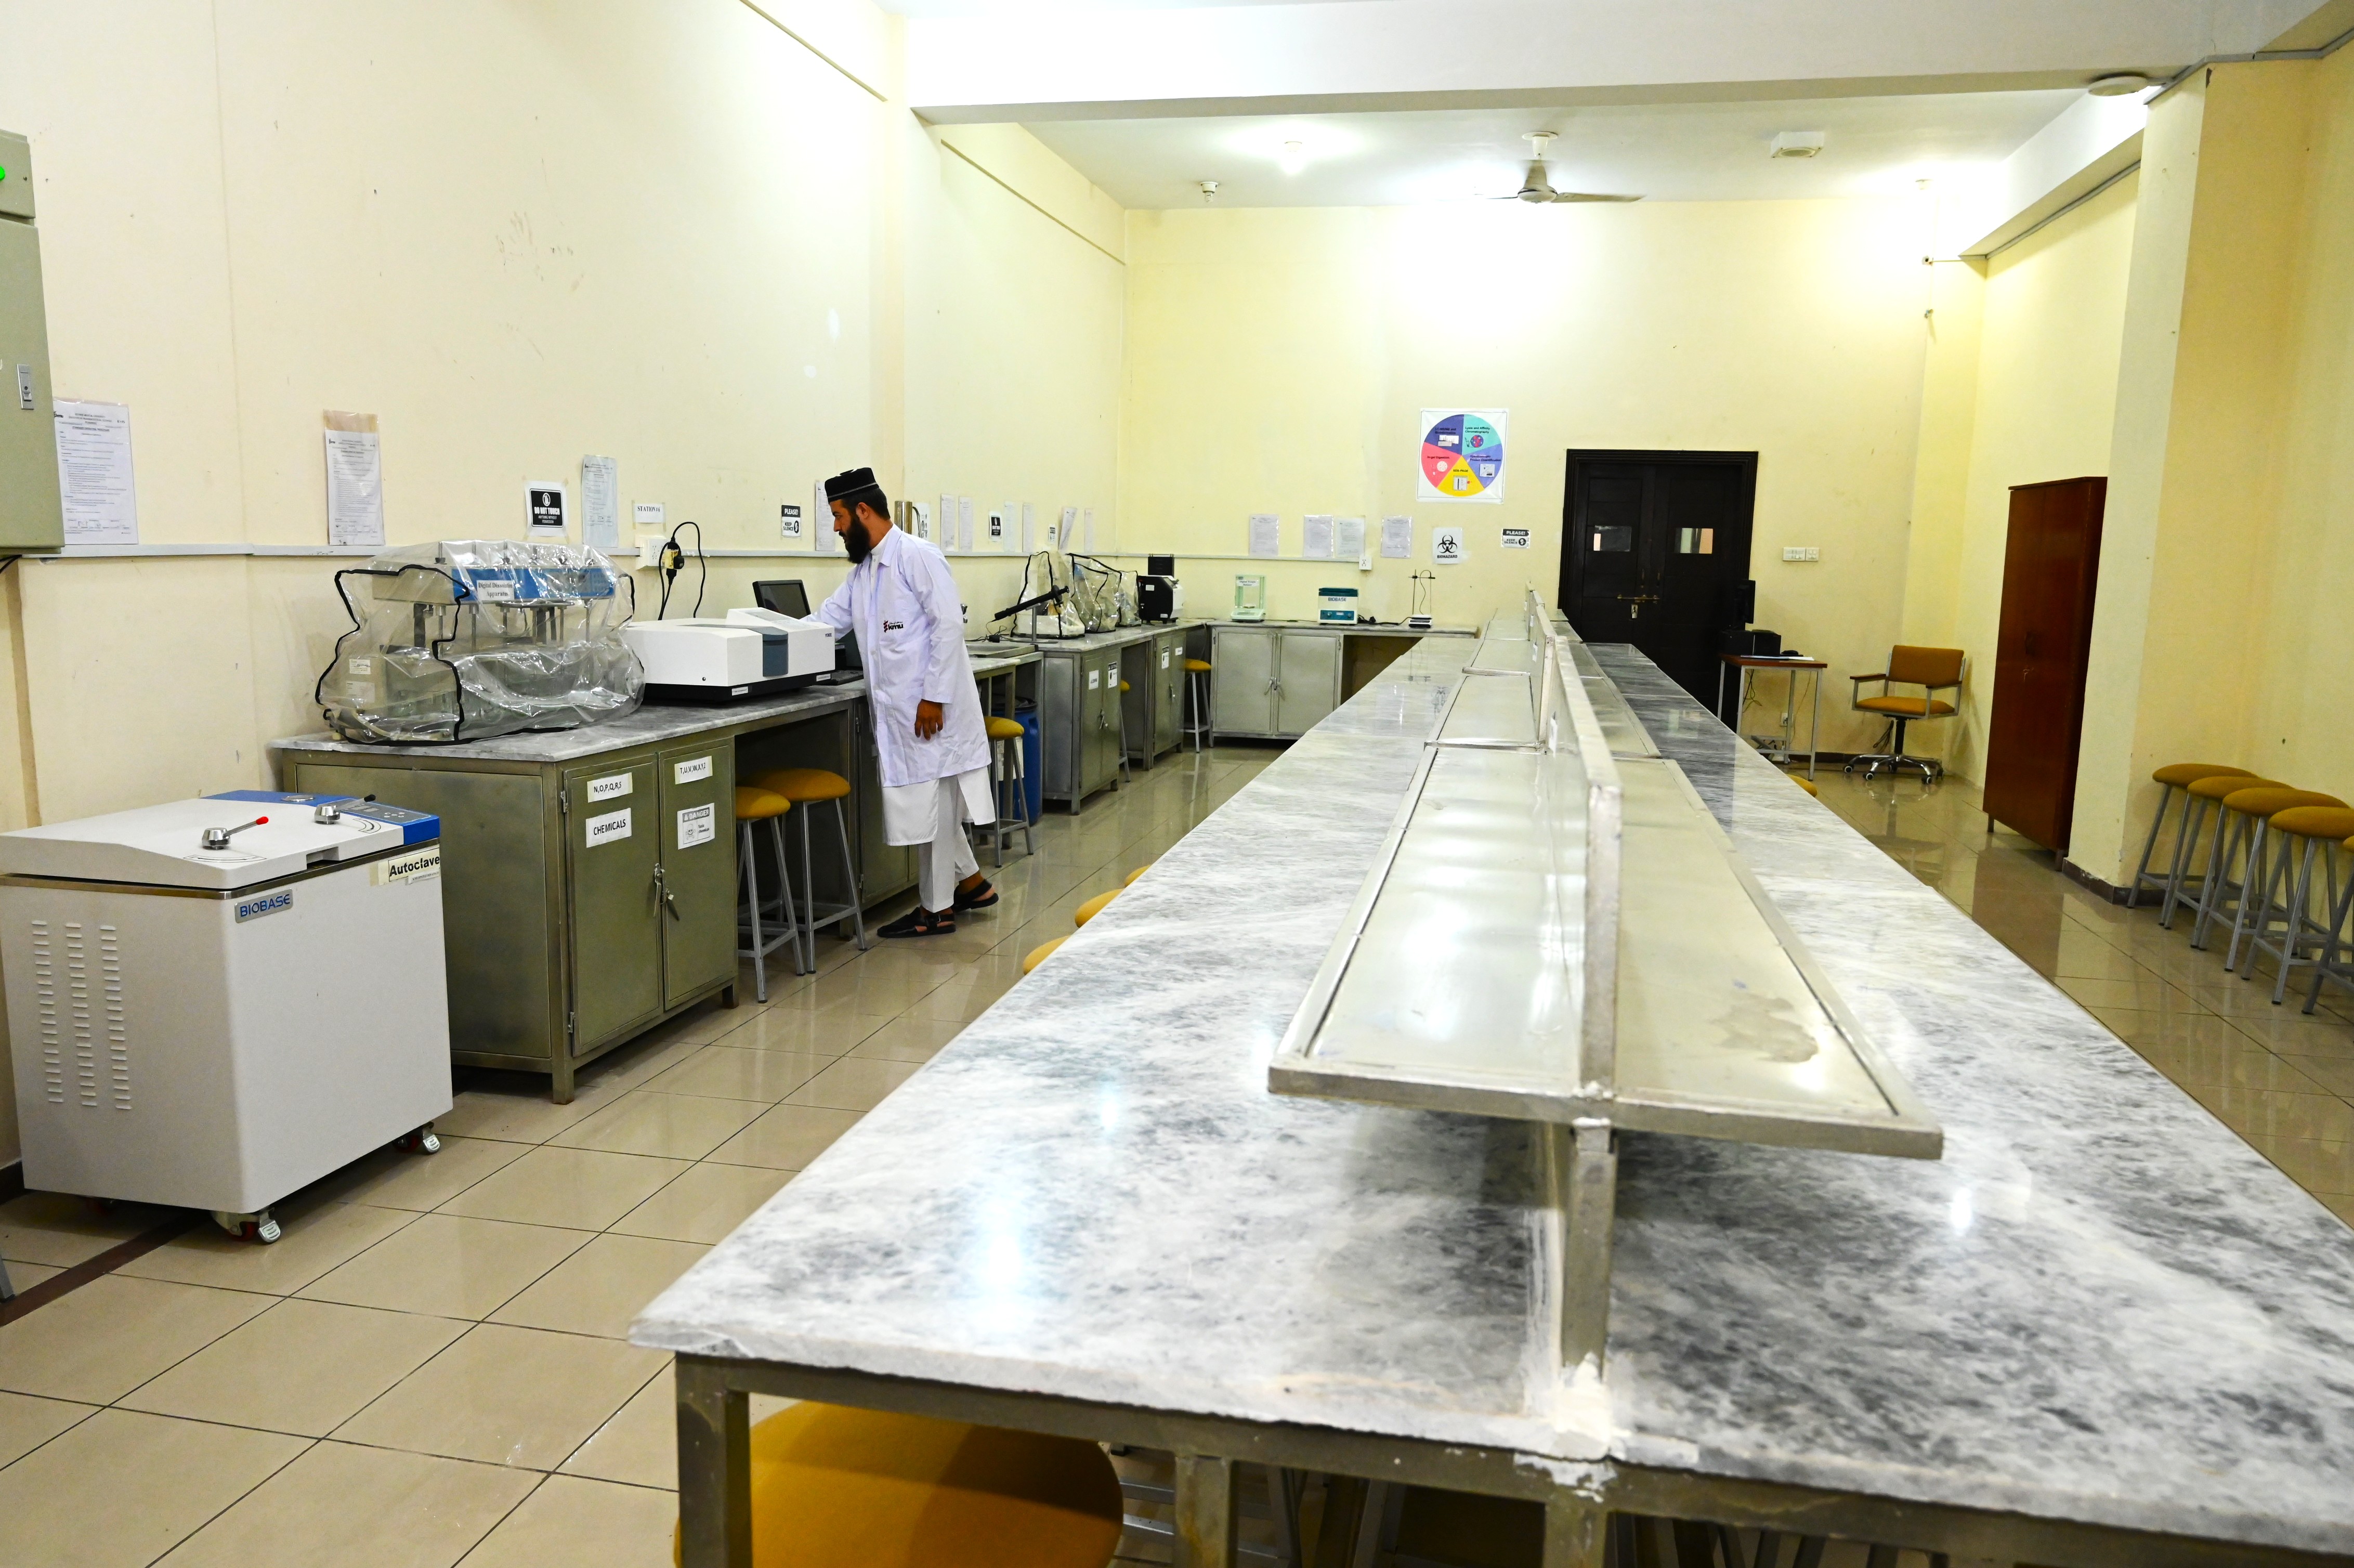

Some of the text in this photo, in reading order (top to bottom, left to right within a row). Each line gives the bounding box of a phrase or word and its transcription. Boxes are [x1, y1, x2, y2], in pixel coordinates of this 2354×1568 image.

[689, 809, 709, 819] DANGER
[593, 819, 626, 835] CHEMICALS
[389, 856, 440, 877] Autoclave
[240, 894, 291, 917] BIOBASE
